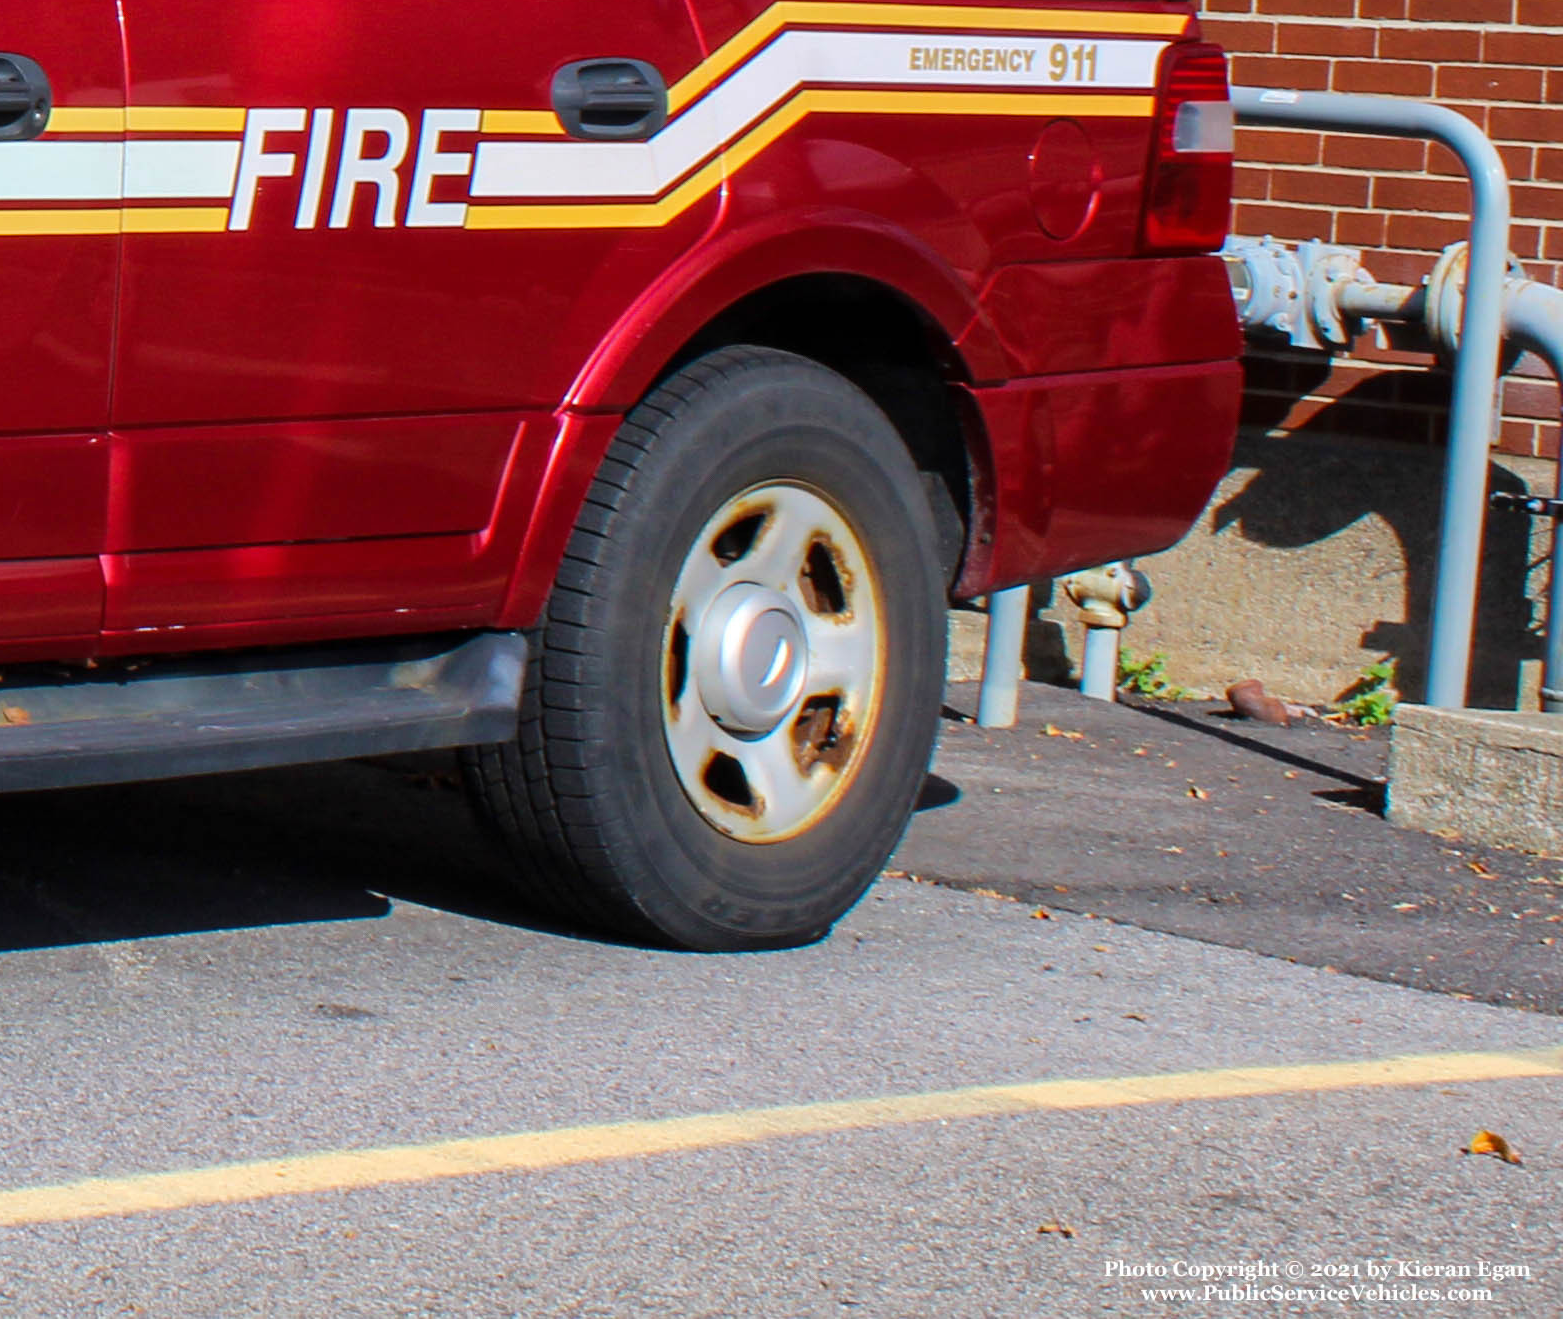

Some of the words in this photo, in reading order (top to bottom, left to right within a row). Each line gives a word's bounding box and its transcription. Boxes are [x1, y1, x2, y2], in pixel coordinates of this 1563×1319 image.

[909, 47, 1037, 72] EMERGENCY
[1048, 43, 1098, 82] 911
[228, 107, 482, 231] FIRE
